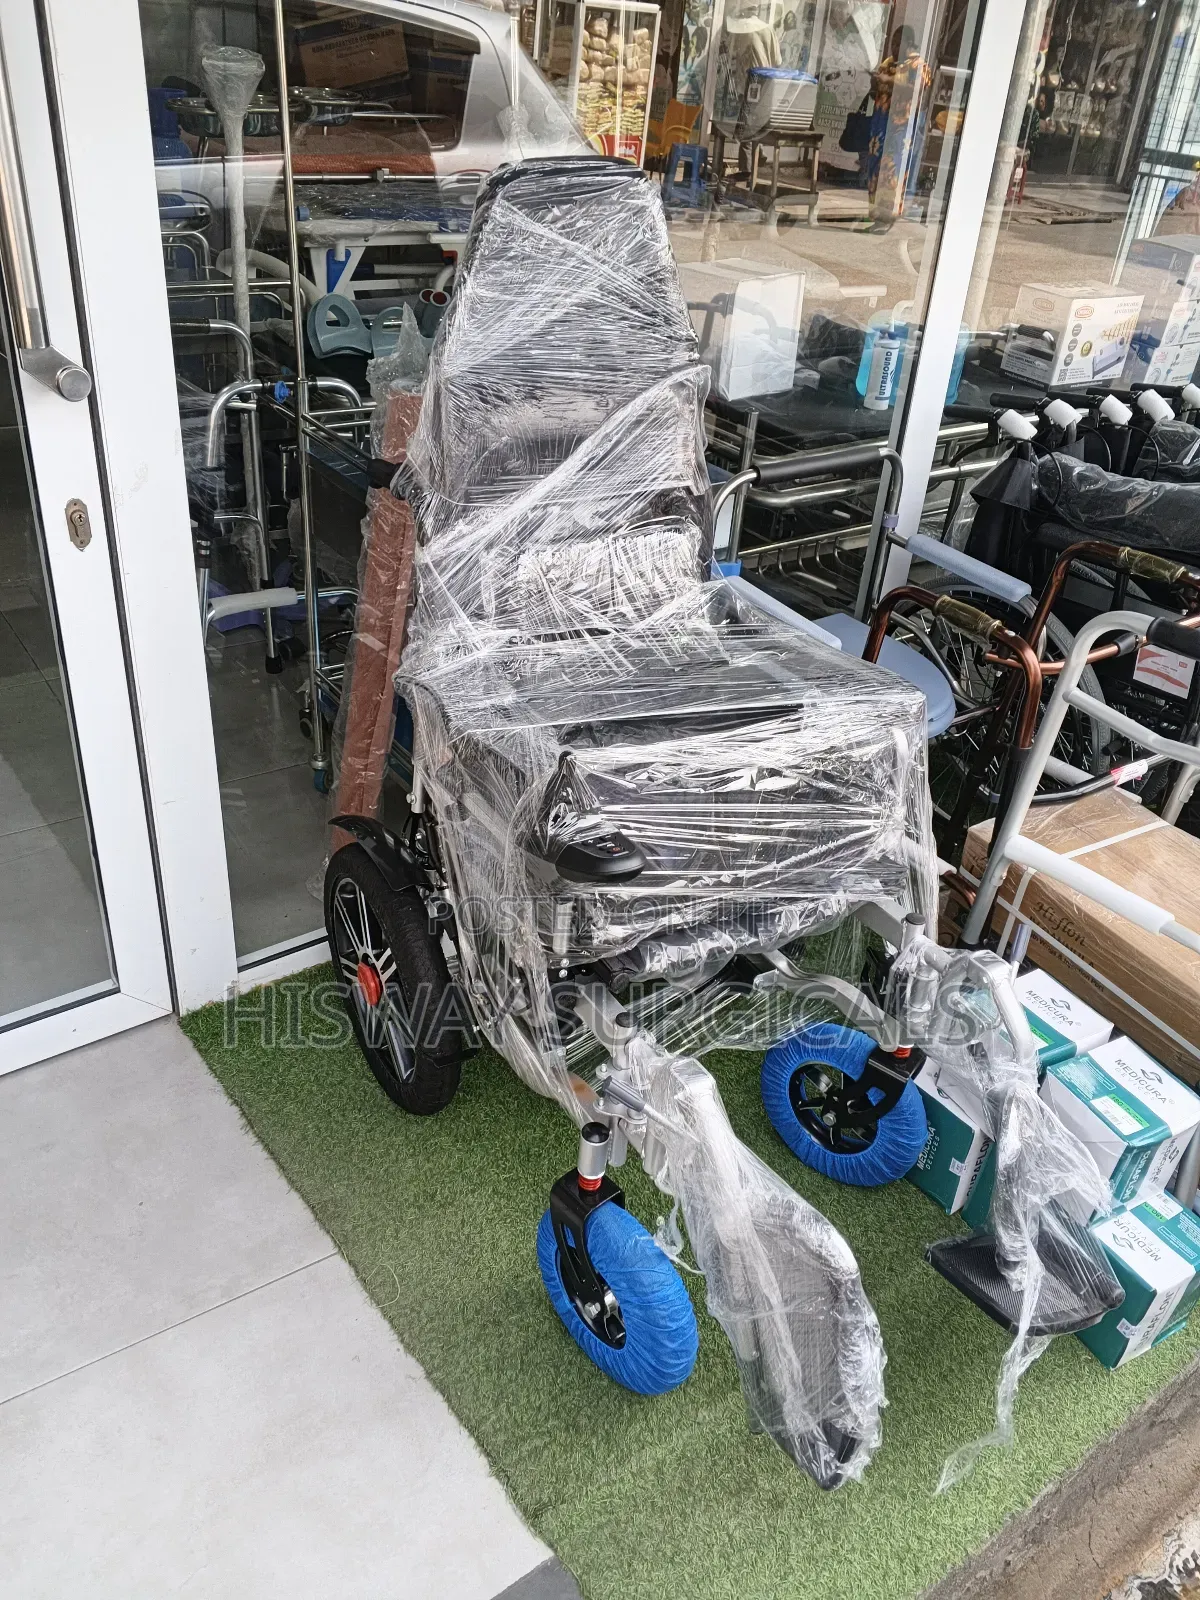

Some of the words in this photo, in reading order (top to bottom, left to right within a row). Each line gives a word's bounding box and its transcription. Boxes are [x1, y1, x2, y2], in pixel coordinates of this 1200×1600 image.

[879, 351, 892, 396] ULTRASOUND
[1026, 990, 1074, 1027] MEDICURA
[1115, 1059, 1167, 1104] MEDICURA
[926, 1136, 940, 1170] DEVICES
[1113, 1219, 1161, 1262] MEDICUR
